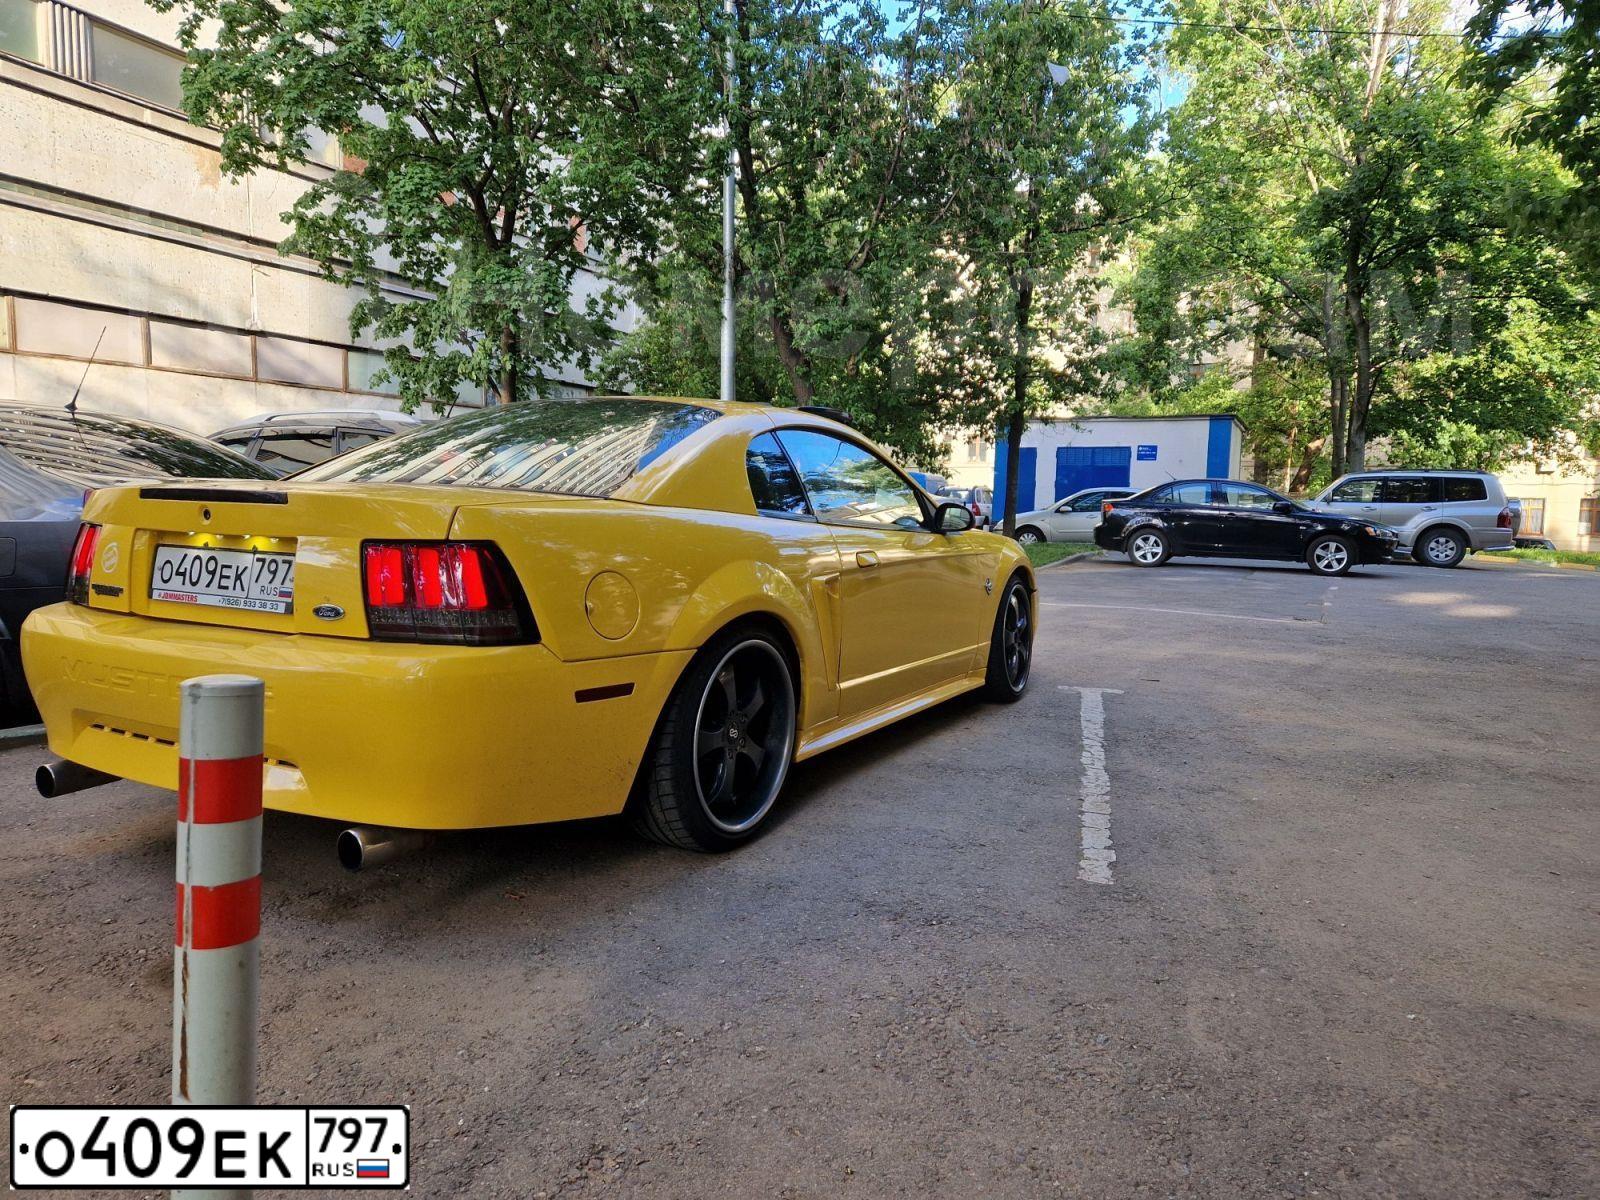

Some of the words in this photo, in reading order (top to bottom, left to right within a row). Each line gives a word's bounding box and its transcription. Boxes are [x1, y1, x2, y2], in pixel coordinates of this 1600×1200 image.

[255, 557, 293, 586] 797
[259, 585, 279, 596] RUS
[243, 600, 256, 608] 933
[318, 606, 337, 617] Ford
